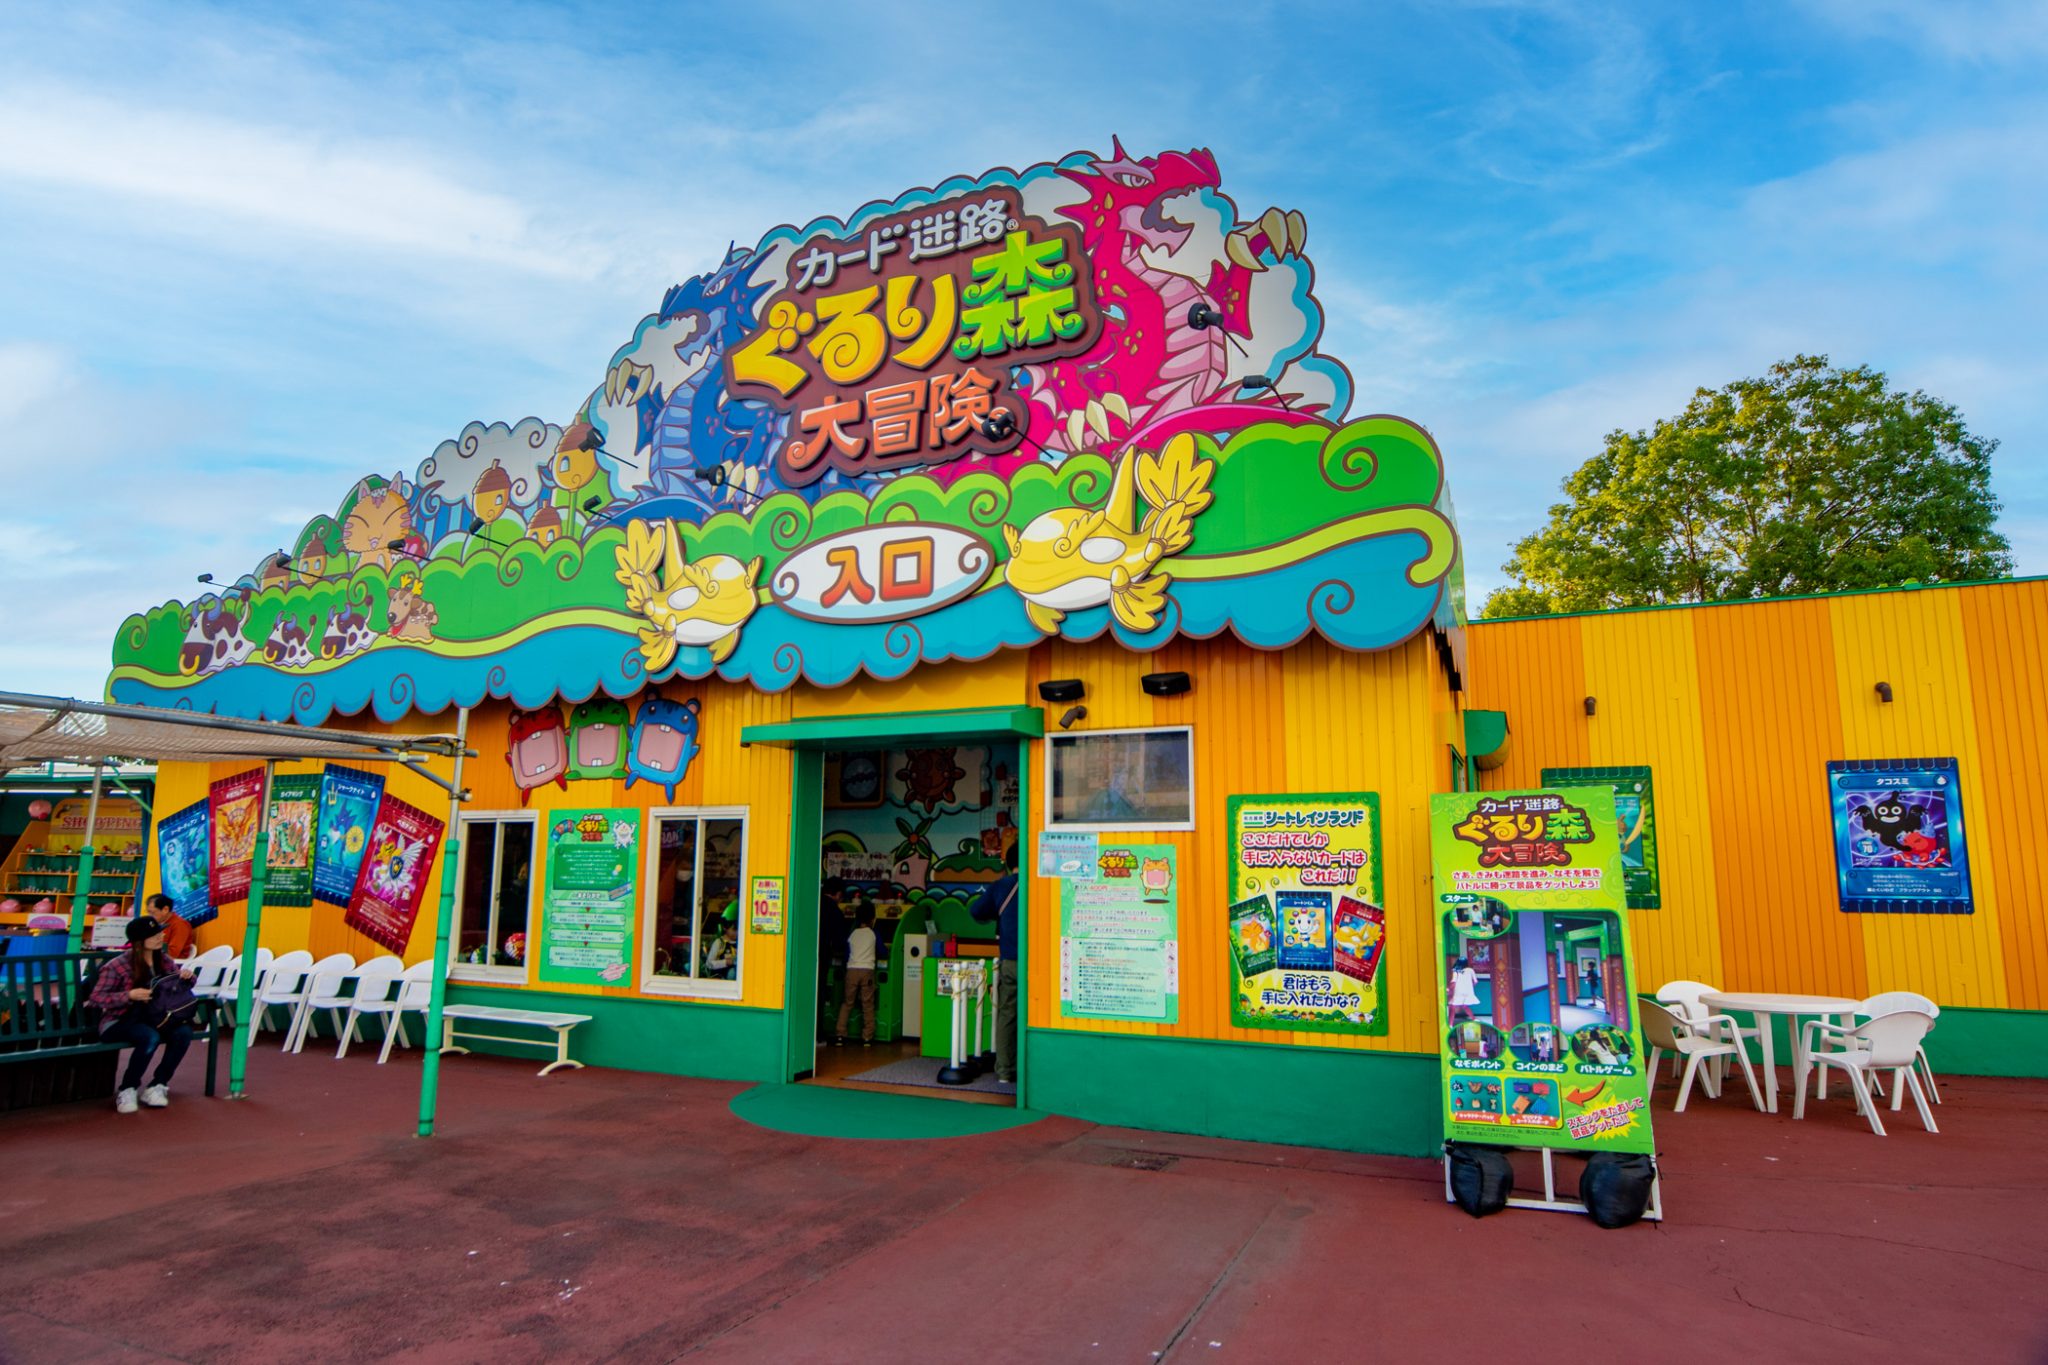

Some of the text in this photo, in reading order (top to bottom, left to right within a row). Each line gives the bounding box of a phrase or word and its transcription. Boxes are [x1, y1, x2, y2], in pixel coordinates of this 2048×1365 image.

[731, 230, 1083, 393] ぐるり森
[787, 367, 1011, 470] 大冒険
[819, 535, 938, 608] 入口
[1876, 777, 1910, 786] タコスミ
[1481, 797, 1561, 813] カード迷路
[1265, 810, 1364, 827] シートレインランド
[1458, 808, 1590, 842] ぐるり森
[1243, 832, 1329, 847] ここだけでしか
[1243, 850, 1366, 866] 手に入らないカードは
[1483, 843, 1567, 864] 大冒険
[1098, 856, 1138, 869] ぐるり森
[1445, 894, 1475, 902] スタート
[754, 900, 769, 917] 10
[1283, 976, 1332, 991] 君はもう
[1261, 992, 1361, 1008] 手に入れたかな?
[1455, 1059, 1501, 1070] なぞポイント
[1516, 1062, 1564, 1072] コインのまど
[1580, 1063, 1632, 1074] バトルゲーム
